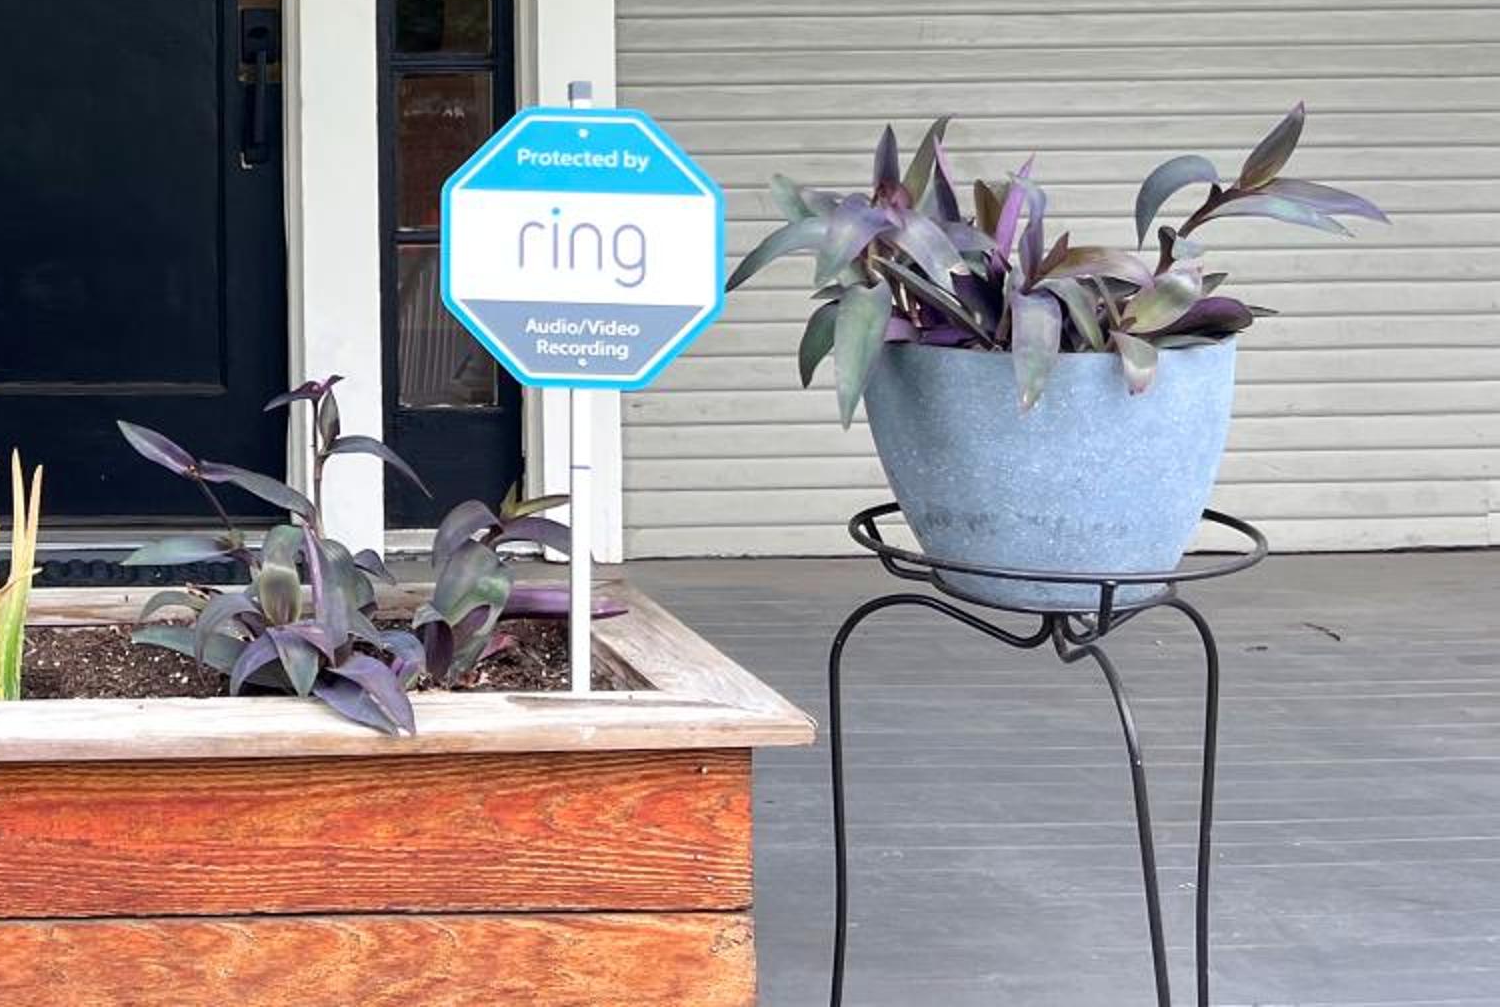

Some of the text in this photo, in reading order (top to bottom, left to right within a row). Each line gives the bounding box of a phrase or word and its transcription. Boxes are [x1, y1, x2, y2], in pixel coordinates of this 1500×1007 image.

[517, 148, 649, 172] Protected by
[518, 207, 647, 288] ring
[525, 318, 640, 336] Audio/Video
[536, 339, 629, 359] Recording
